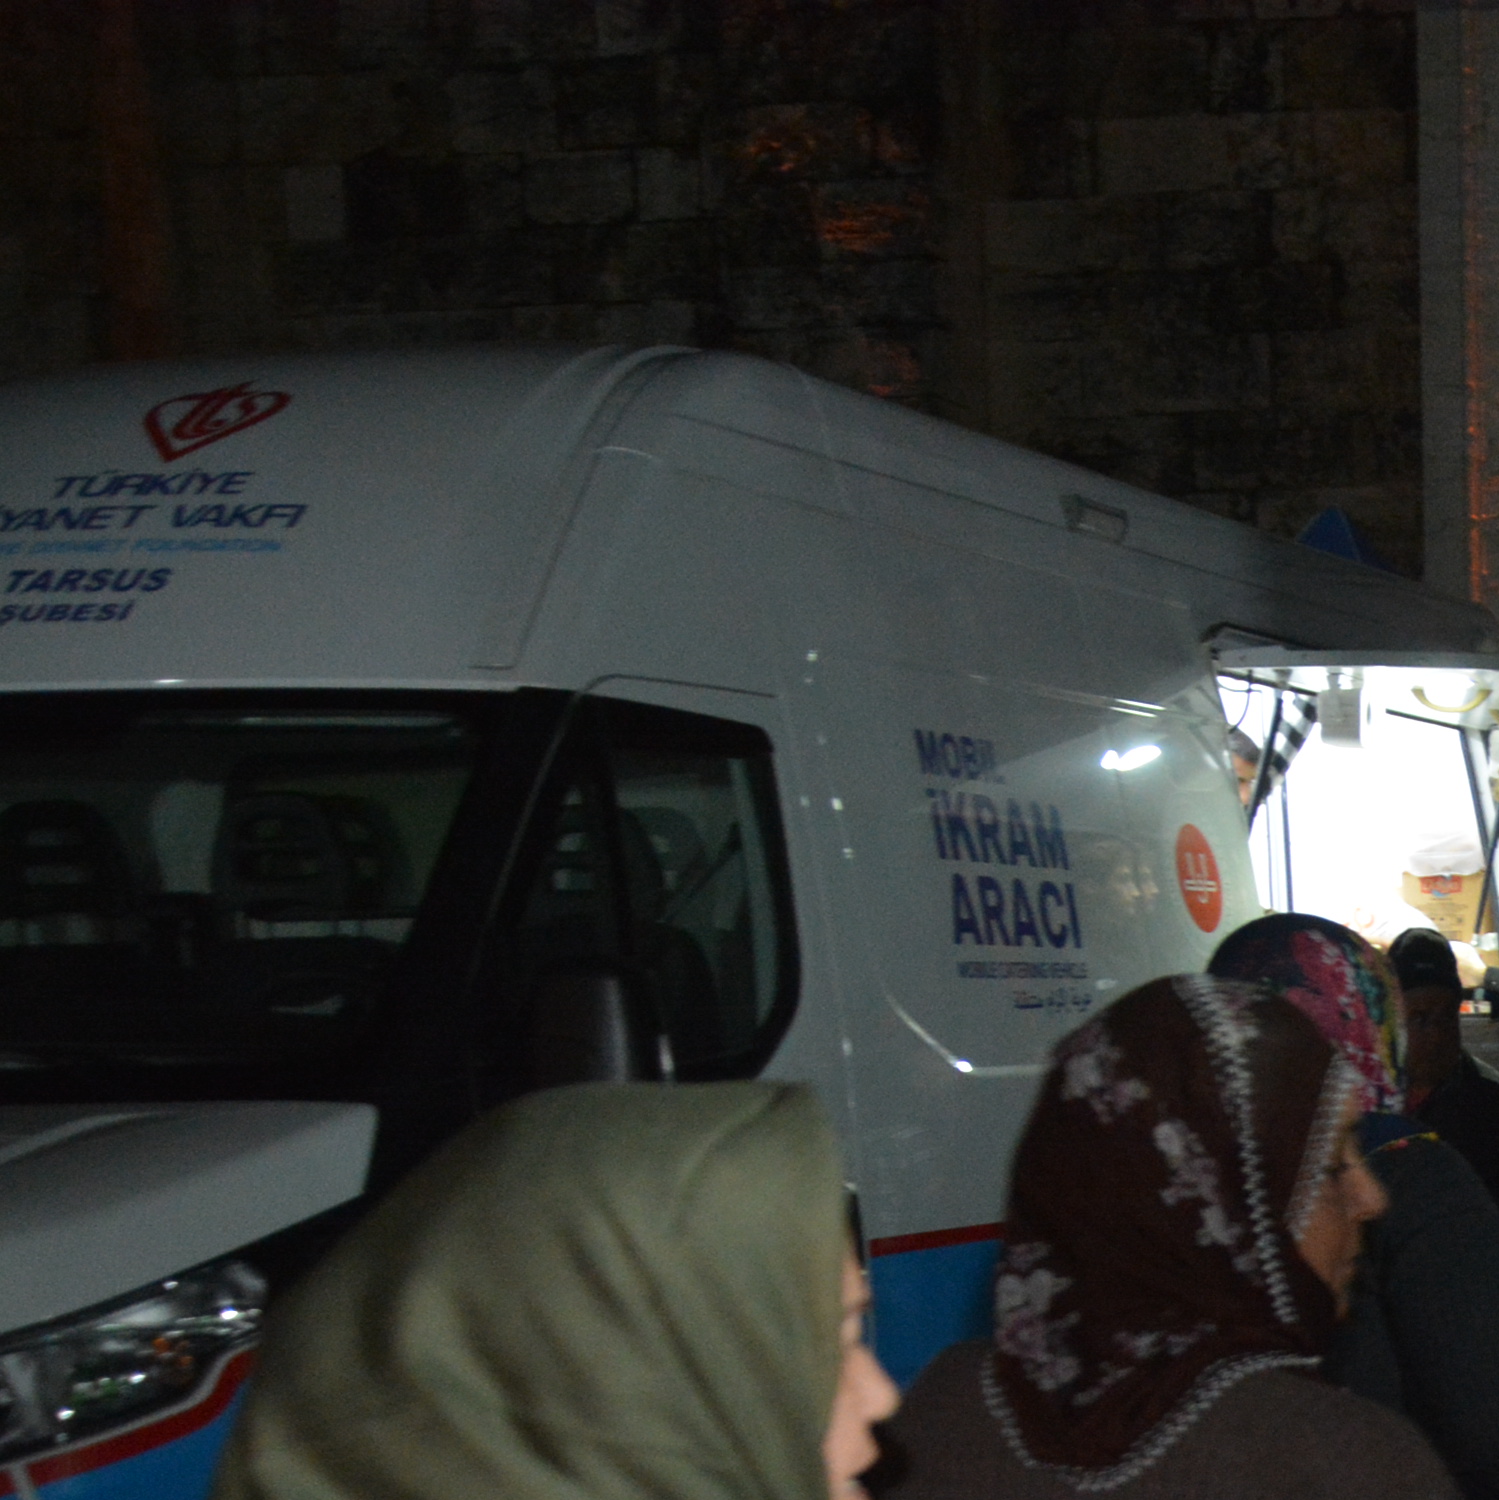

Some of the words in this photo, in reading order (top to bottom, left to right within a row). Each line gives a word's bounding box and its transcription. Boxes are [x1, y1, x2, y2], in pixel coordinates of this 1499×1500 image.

[54, 468, 255, 498] TÜRKİYE
[0, 504, 157, 531] YANET
[172, 503, 308, 529] VAKFI
[6, 567, 172, 593] TARSUS
[925, 788, 1069, 871] İKRAM
[952, 873, 1083, 948] ARACI
